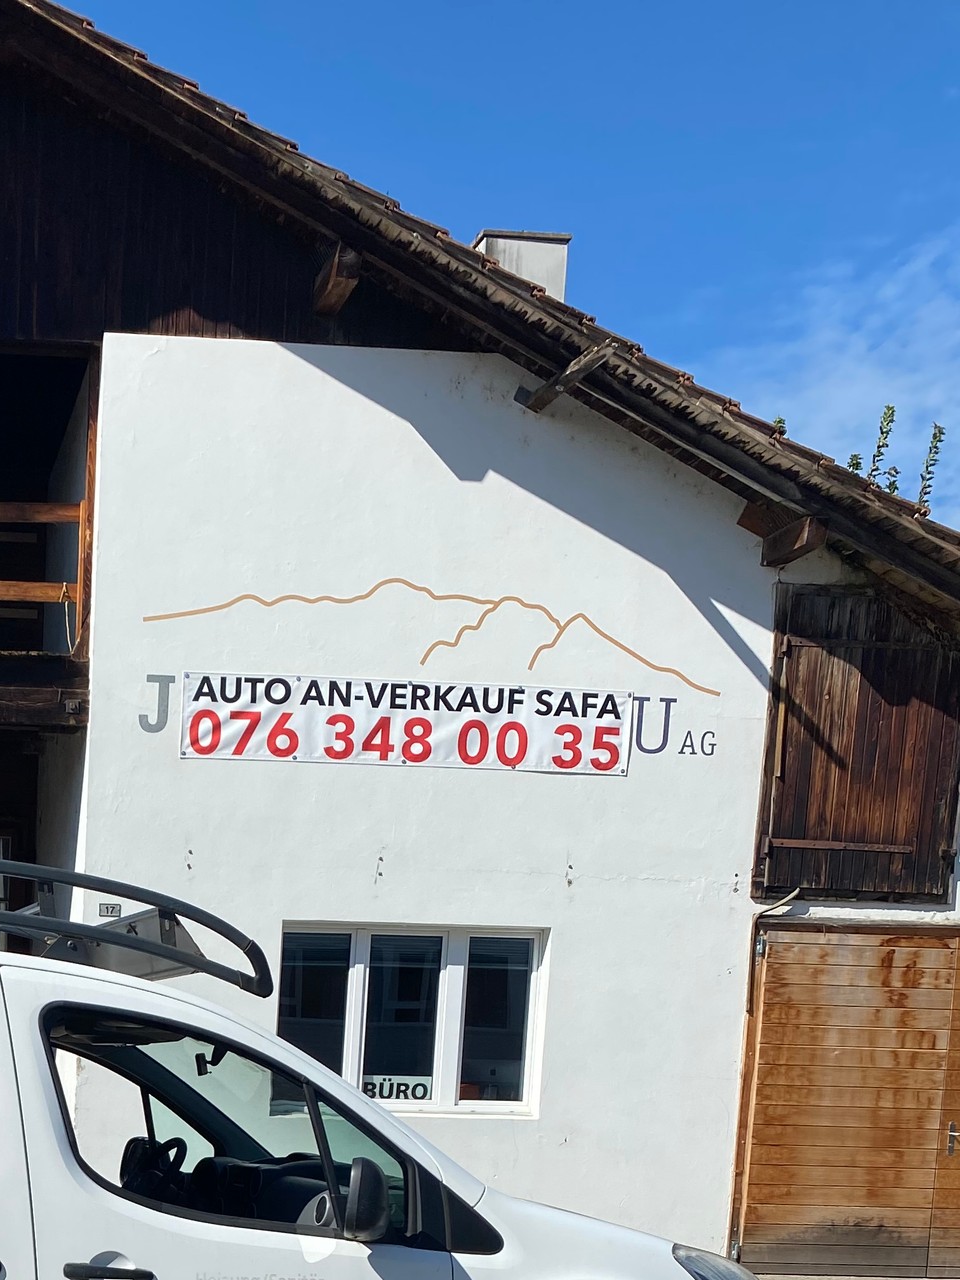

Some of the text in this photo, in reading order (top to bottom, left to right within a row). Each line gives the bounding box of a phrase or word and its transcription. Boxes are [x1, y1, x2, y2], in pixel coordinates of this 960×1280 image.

[192, 676, 622, 720] AUTO AN-VERKAUF SAFA
[189, 708, 620, 771] 076 348 00 35
[678, 730, 717, 756] AG
[105, 906, 116, 915] 17
[363, 1078, 429, 1100] BÜRO
